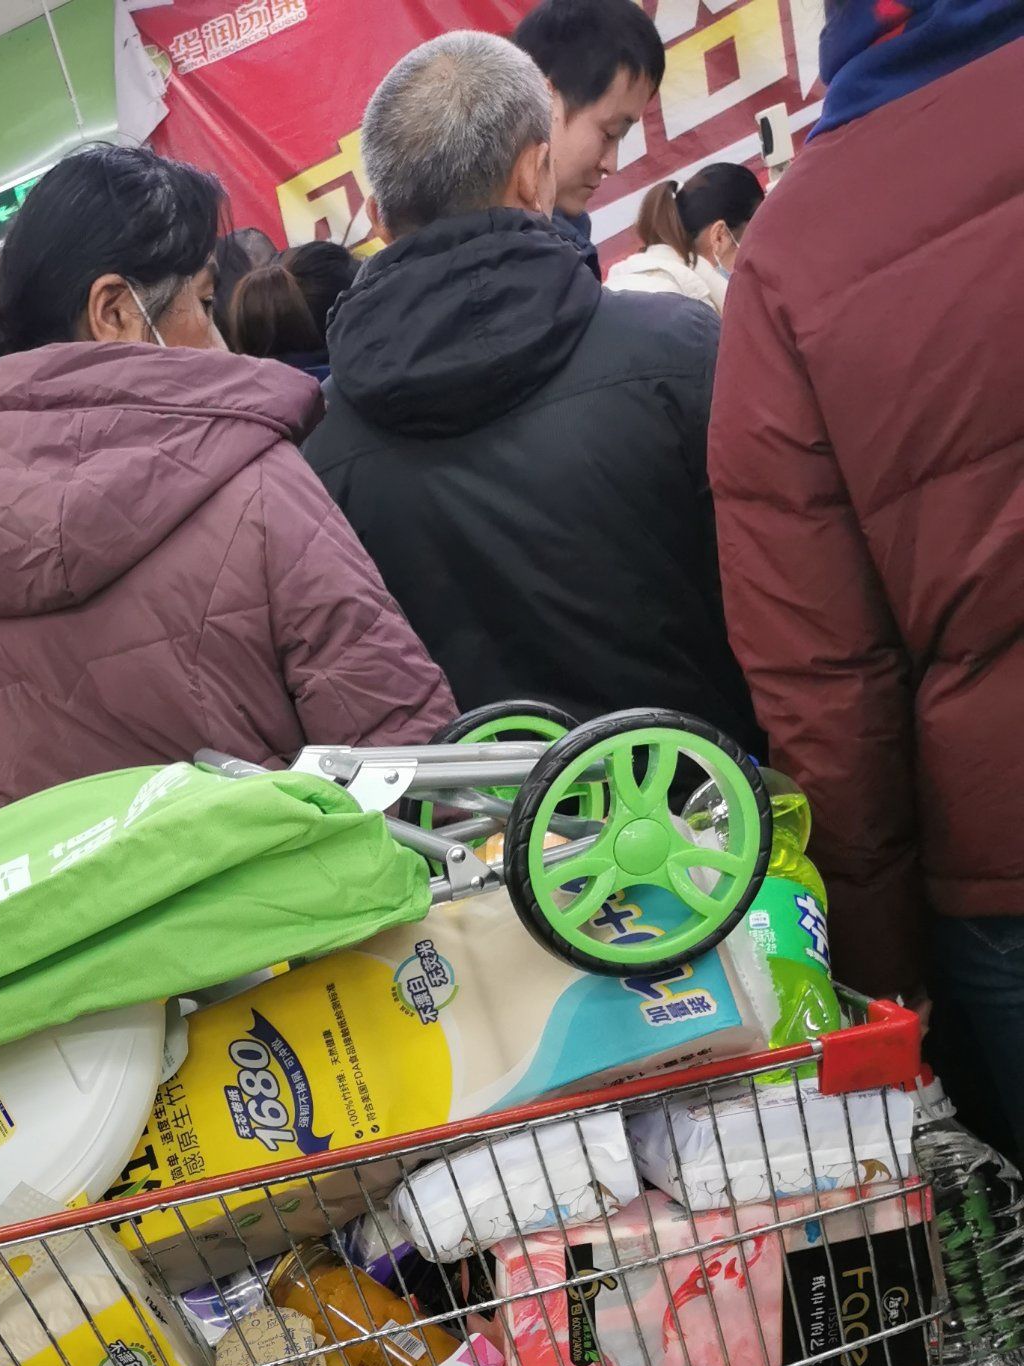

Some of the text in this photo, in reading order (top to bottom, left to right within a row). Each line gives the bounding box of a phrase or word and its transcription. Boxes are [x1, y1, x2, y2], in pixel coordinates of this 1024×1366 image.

[407, 976, 439, 1025] 不漂白
[645, 995, 712, 1024] 加量装
[228, 1039, 297, 1152] 1680
